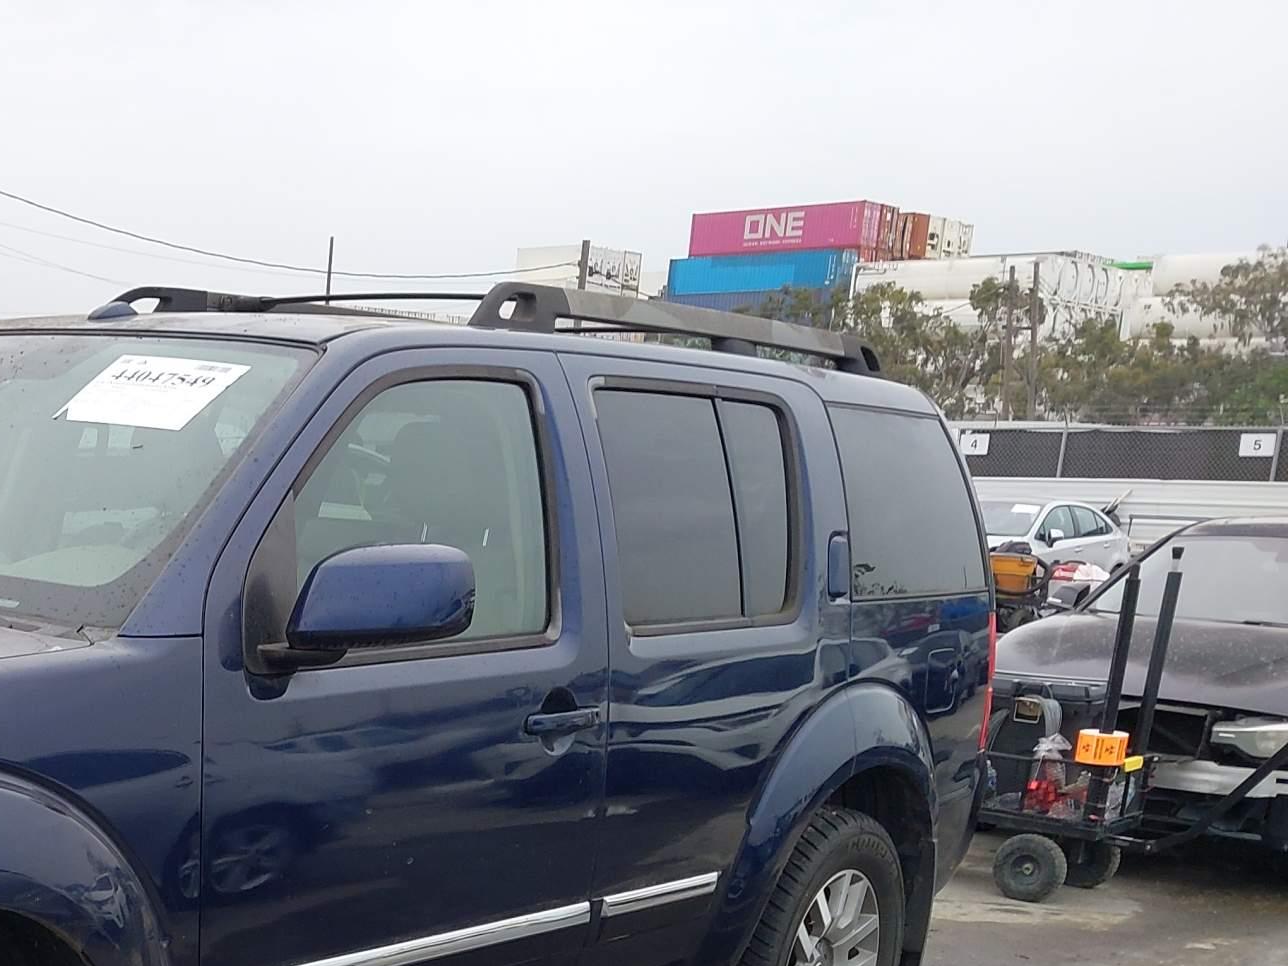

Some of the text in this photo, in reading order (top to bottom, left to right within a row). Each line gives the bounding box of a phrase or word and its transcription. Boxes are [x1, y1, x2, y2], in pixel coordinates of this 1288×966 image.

[743, 211, 805, 239] ONE
[111, 368, 216, 388] 44047549
[970, 439, 978, 450] 4
[1252, 439, 1262, 451] 5
